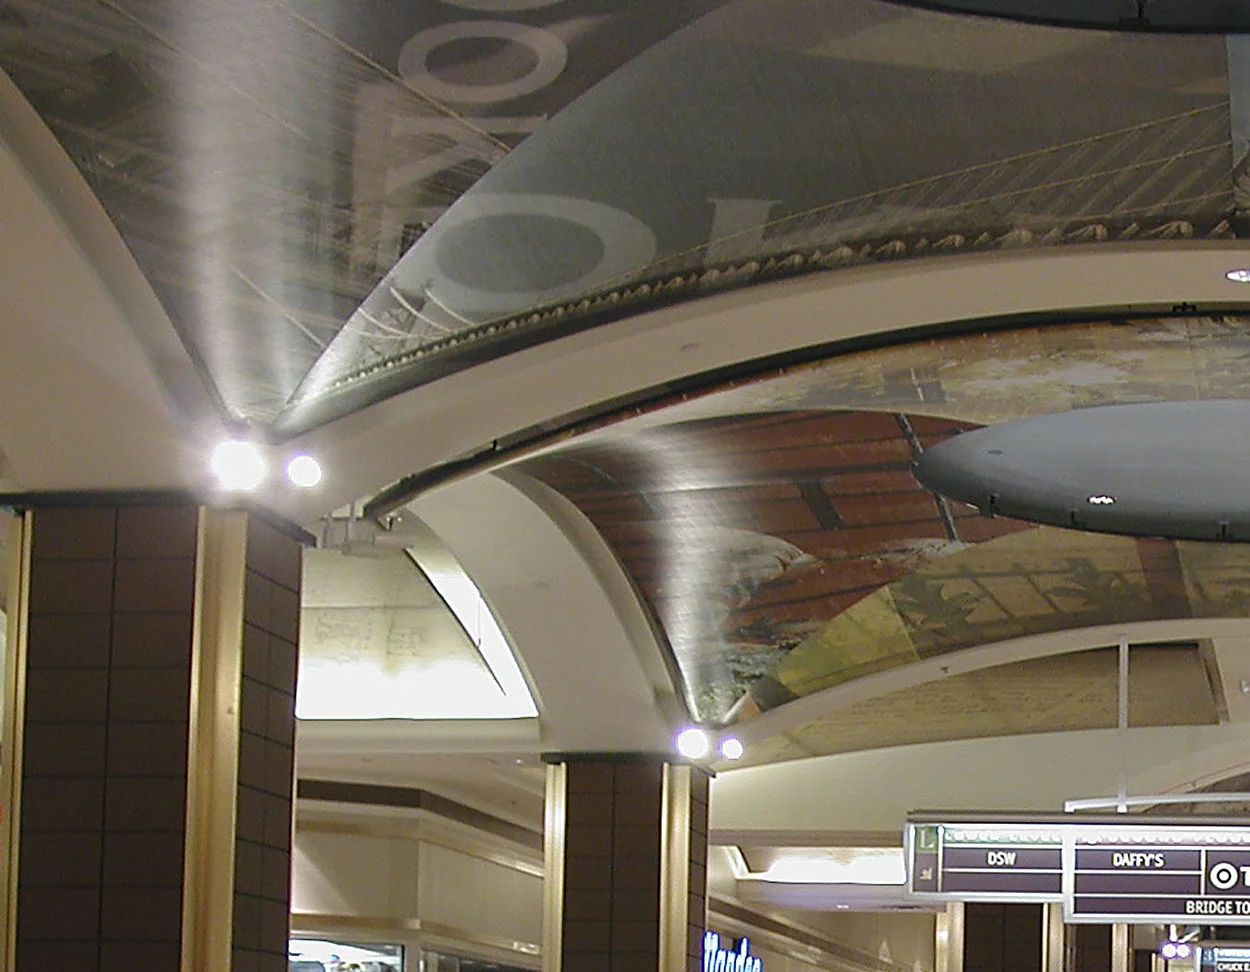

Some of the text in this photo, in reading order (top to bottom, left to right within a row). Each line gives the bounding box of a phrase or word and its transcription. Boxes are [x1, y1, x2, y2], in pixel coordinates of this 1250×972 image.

[987, 852, 1016, 866] DSW
[1112, 853, 1165, 868] DAFFY'S
[1185, 901, 1233, 914] BRIDGE
